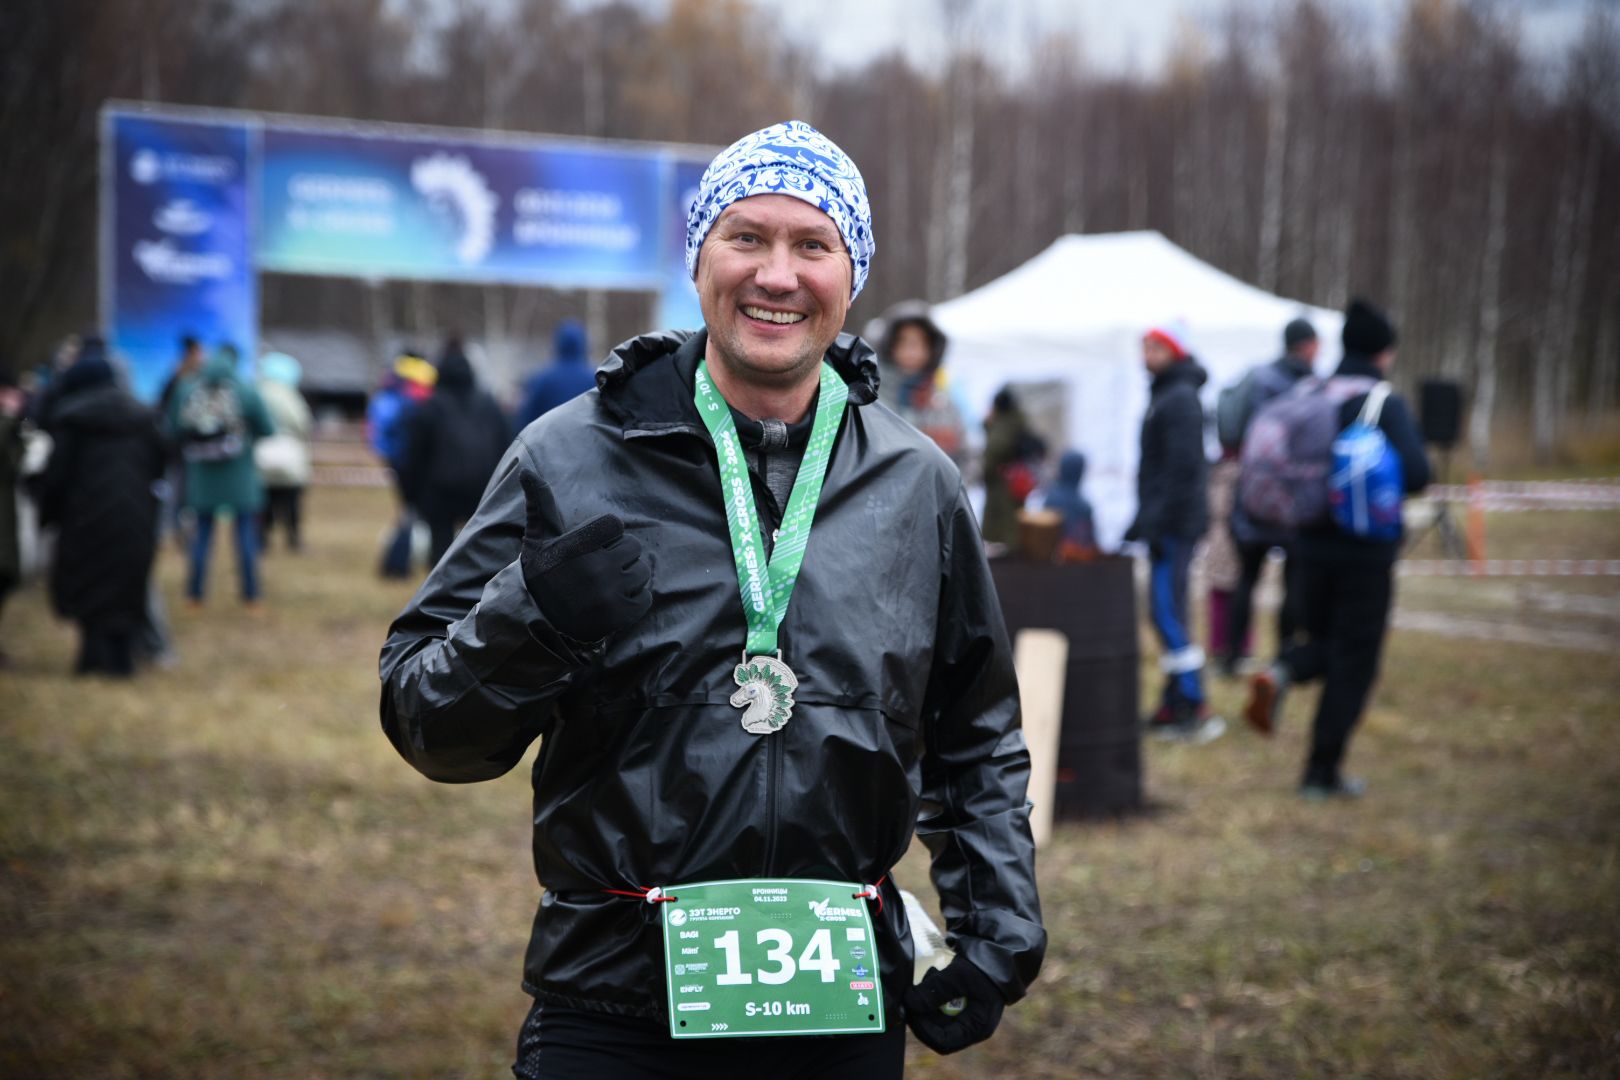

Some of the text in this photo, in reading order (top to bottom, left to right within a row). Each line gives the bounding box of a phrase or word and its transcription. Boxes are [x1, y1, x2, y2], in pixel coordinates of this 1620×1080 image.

[699, 383, 712, 396] 10
[708, 402, 719, 412] S
[731, 477, 754, 545] X-CROSS
[689, 907, 741, 917] ЗЭТ ЭНЕРГО
[713, 927, 840, 986] 134
[745, 1001, 811, 1017] S-10 km
